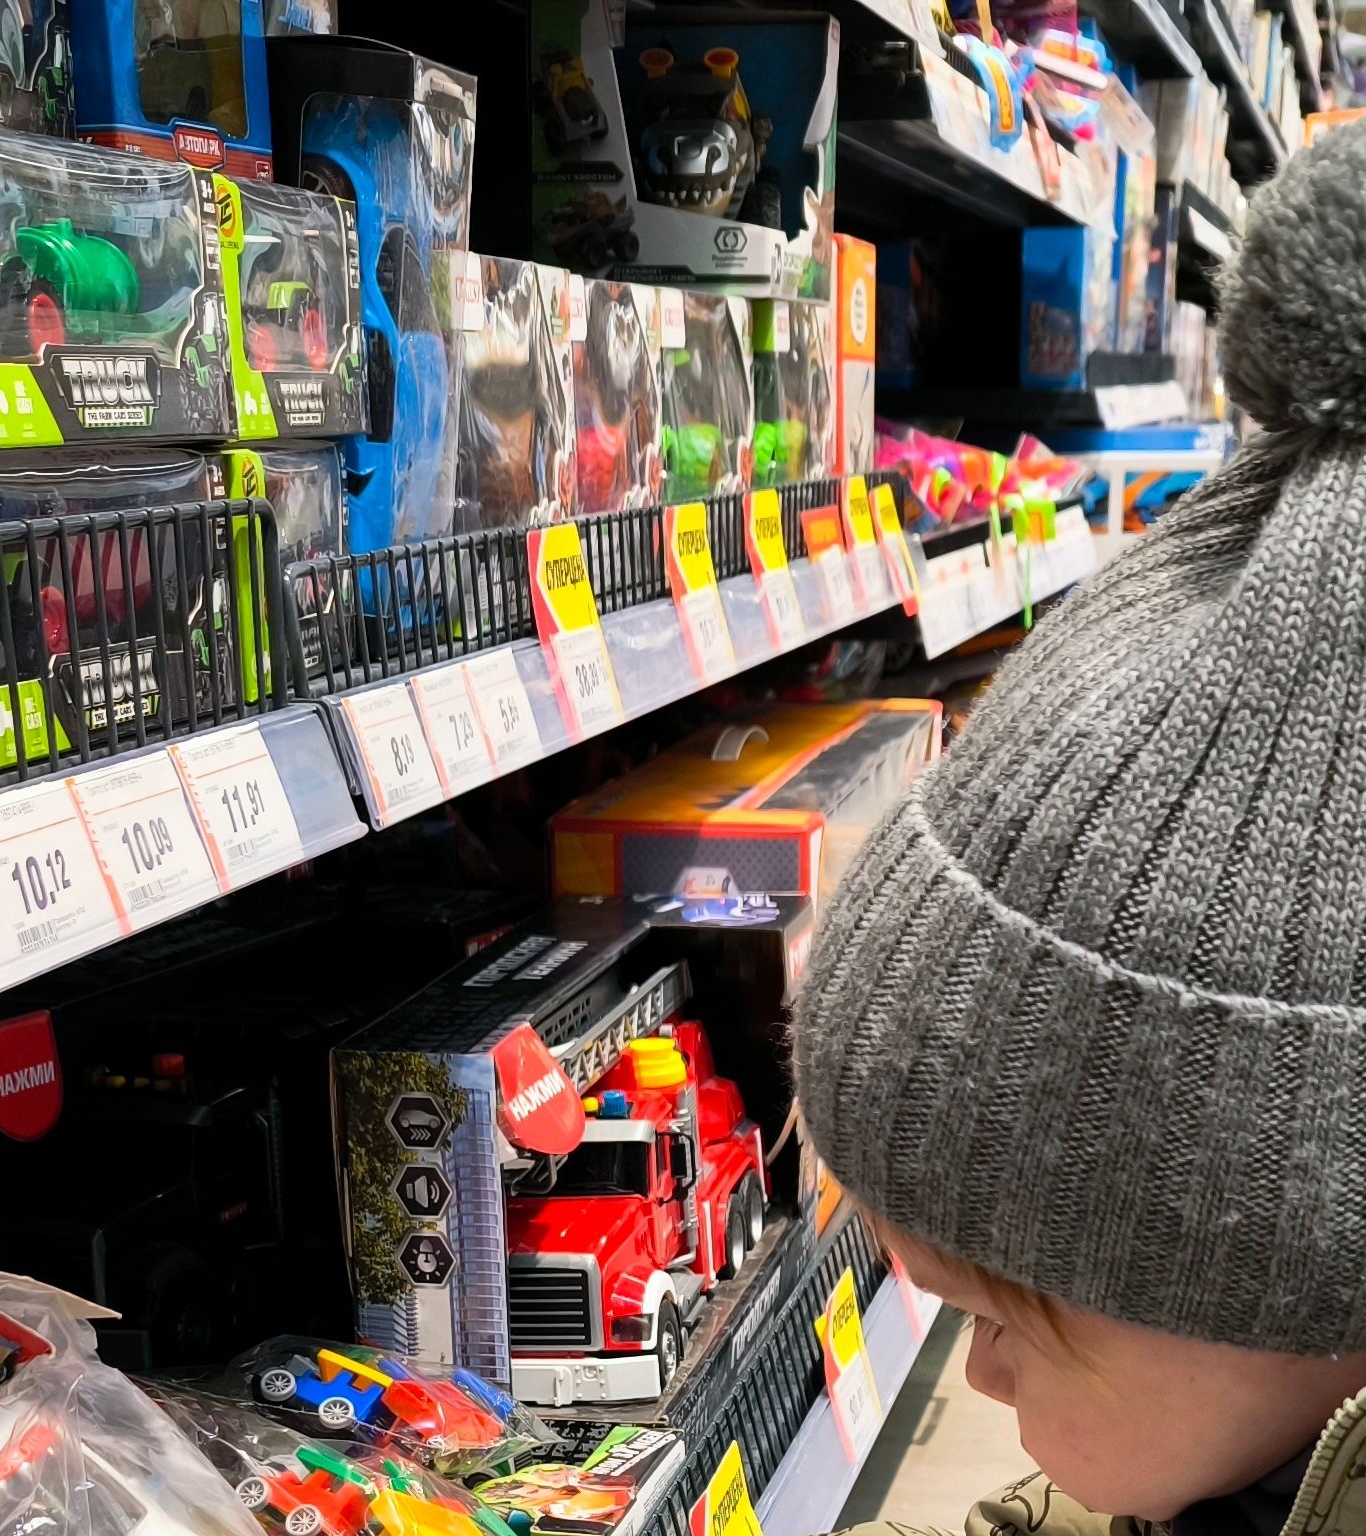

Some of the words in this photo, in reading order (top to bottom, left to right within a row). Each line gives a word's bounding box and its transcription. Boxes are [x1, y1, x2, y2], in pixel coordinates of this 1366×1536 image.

[60, 356, 156, 407] TRUCK
[677, 525, 707, 558] СУПЕРЦЕНА
[545, 554, 588, 592] СУПЕРЦЕНА
[390, 733, 415, 777] 8,19
[449, 711, 475, 751] 7,29
[221, 779, 266, 833] 11,91
[121, 816, 174, 875] 10,09
[11, 848, 73, 915] 10,12
[507, 1068, 565, 1122] НАЖМИ
